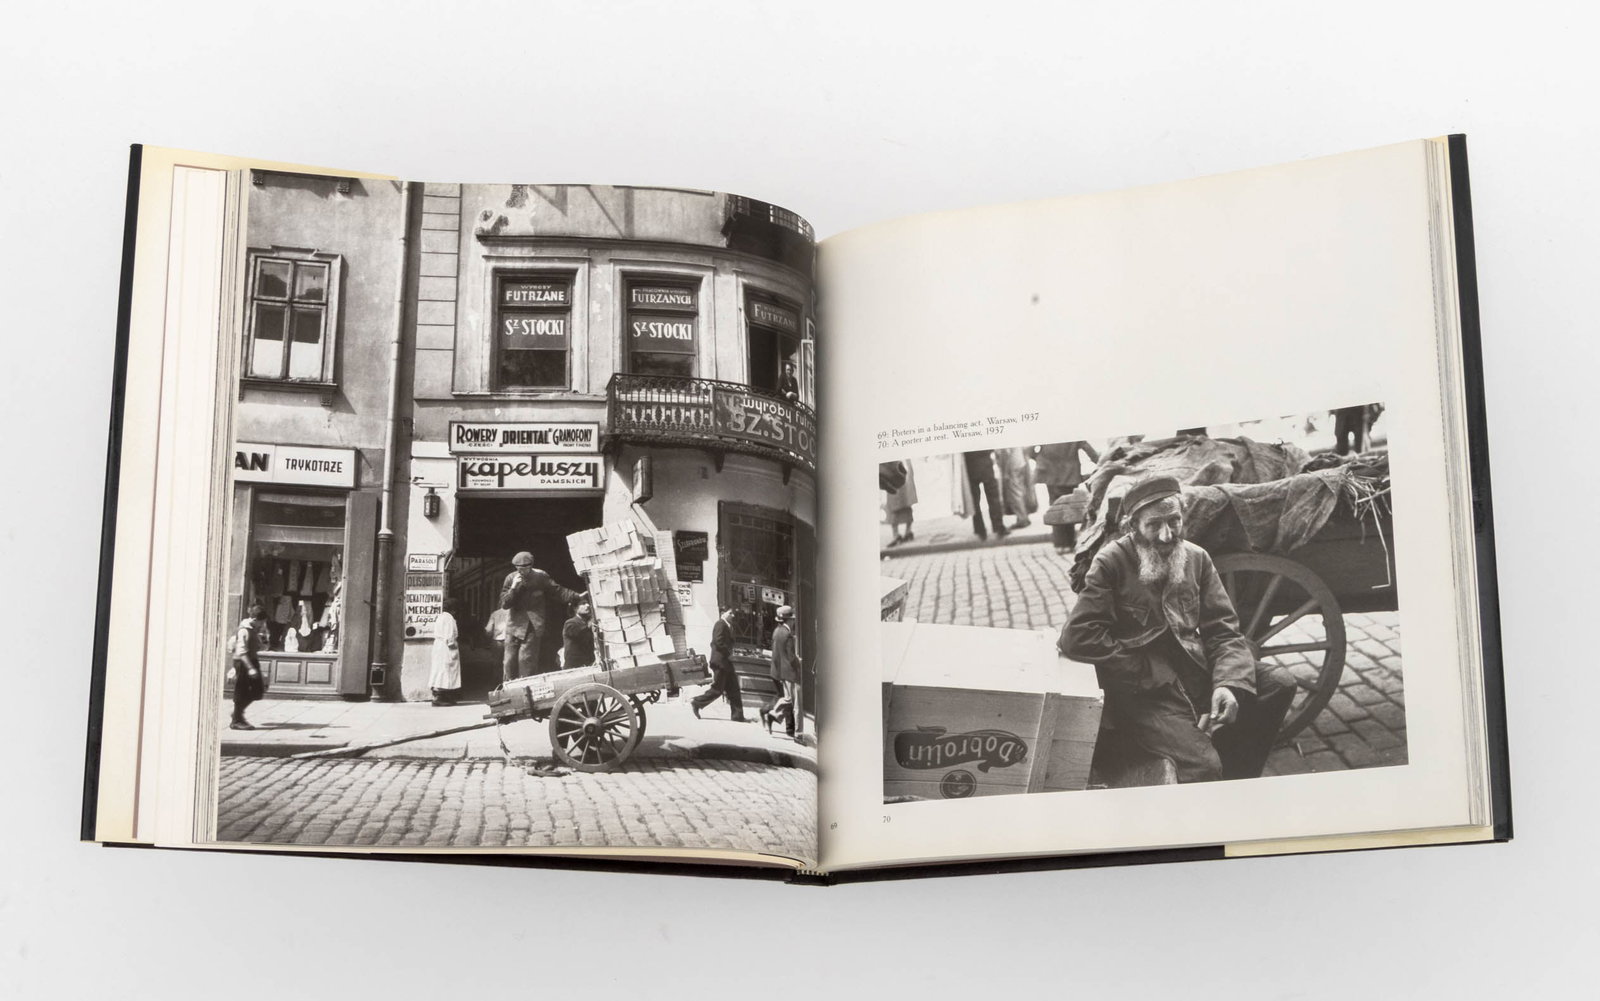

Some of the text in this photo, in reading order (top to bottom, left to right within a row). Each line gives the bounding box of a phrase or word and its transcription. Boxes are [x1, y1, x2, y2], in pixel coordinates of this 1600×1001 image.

[505, 290, 565, 301] FUTRZANE
[632, 289, 692, 304] FUTRZANYCH
[521, 319, 564, 335] STOCKI
[649, 321, 692, 340] STOCKI
[891, 428, 916, 437] Porters
[933, 421, 968, 432] balancing
[987, 416, 1018, 425] Warsaw,
[1021, 412, 1040, 422] 1937
[456, 425, 497, 444] ROWERY
[552, 428, 593, 446] GRAMOFONY
[891, 439, 900, 447] A
[901, 437, 923, 447] porter
[952, 430, 983, 438] Warsaw,
[986, 425, 1005, 435] 1937
[830, 822, 838, 830] 69
[882, 815, 892, 823] 70
